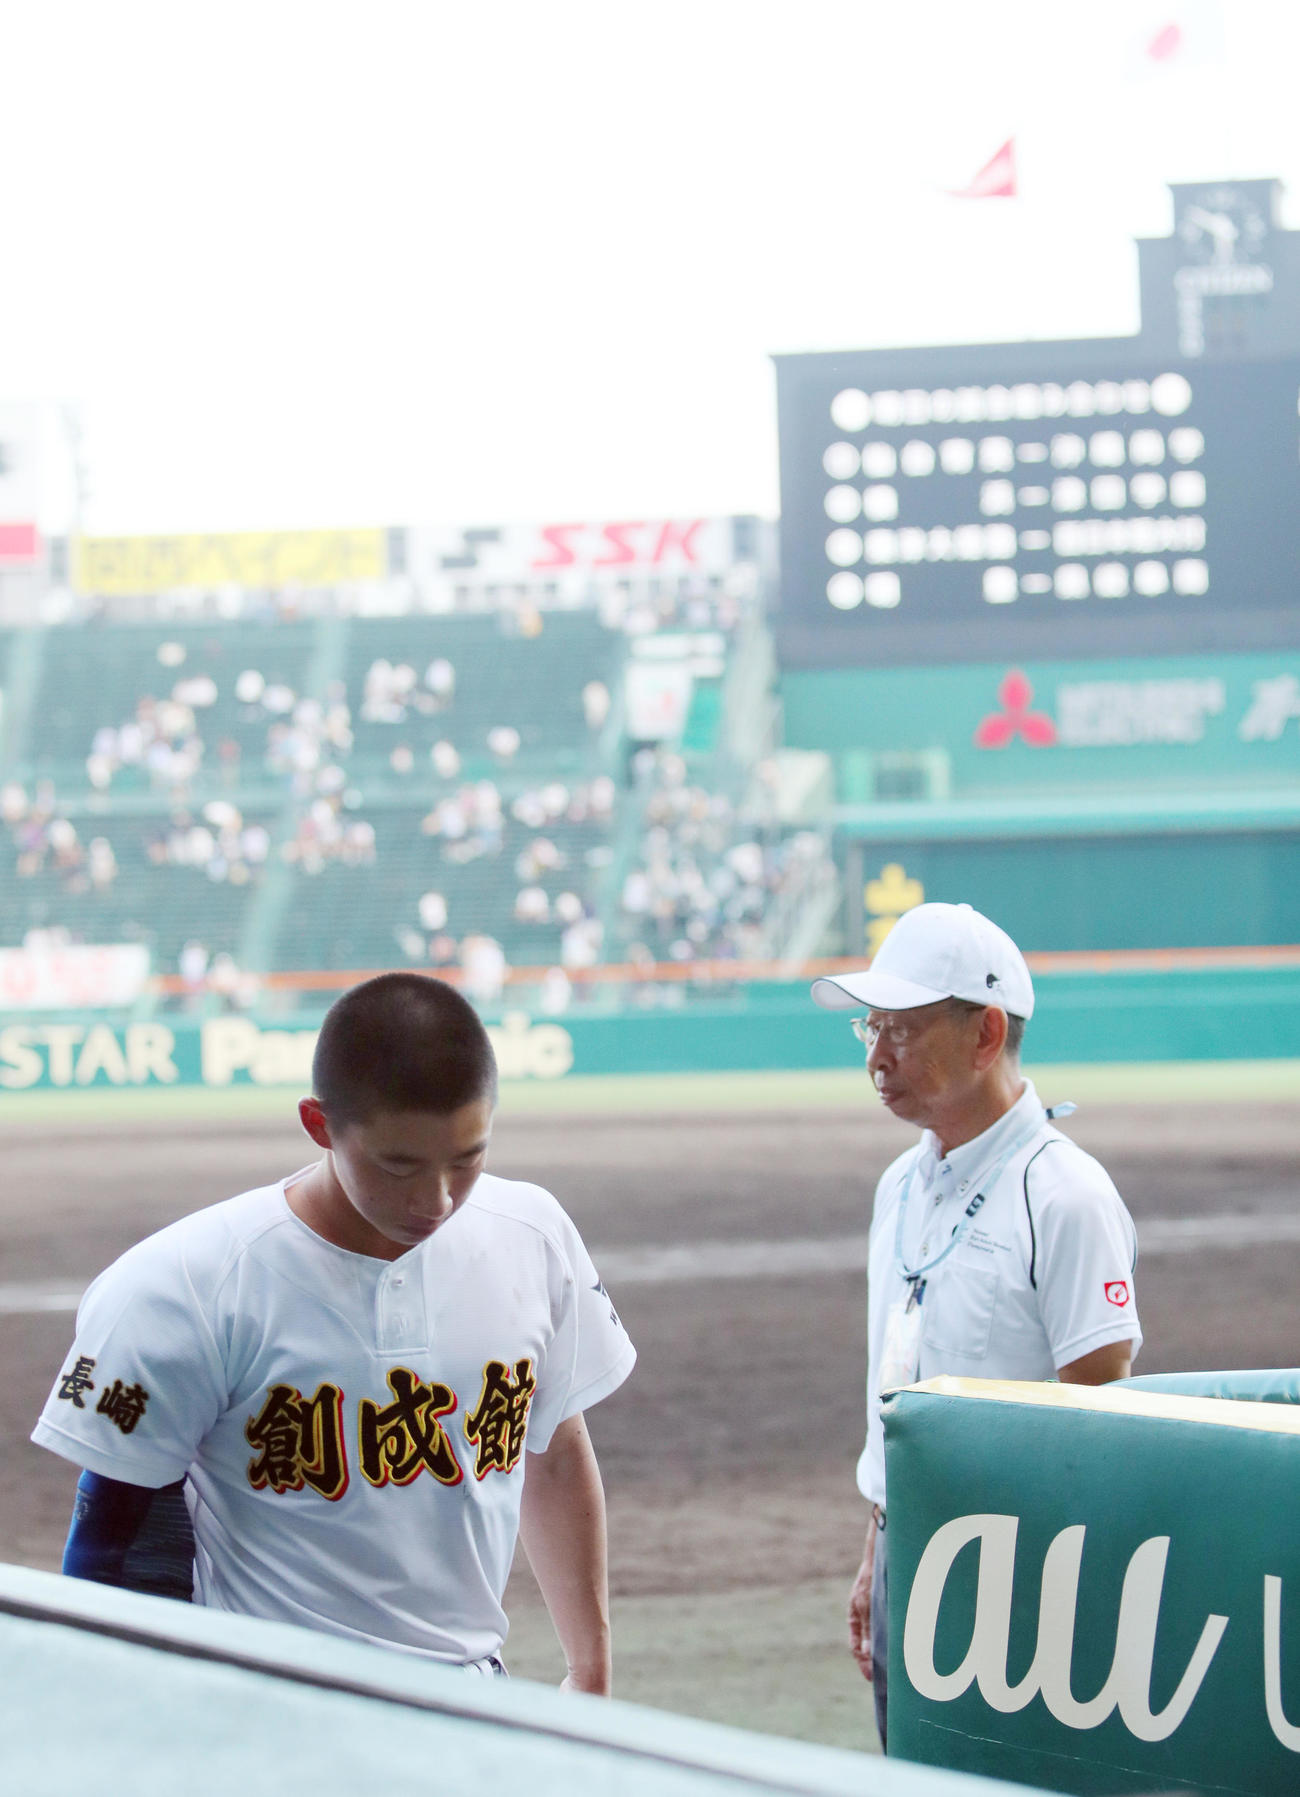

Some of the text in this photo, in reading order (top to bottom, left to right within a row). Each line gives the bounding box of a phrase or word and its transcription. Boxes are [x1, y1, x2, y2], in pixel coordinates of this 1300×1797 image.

[531, 519, 708, 569] SSK
[0, 1023, 179, 1088] STAR
[58, 1356, 150, 1434] 長崎
[244, 1358, 536, 1502] 創成館
[903, 1513, 1230, 1743] au
